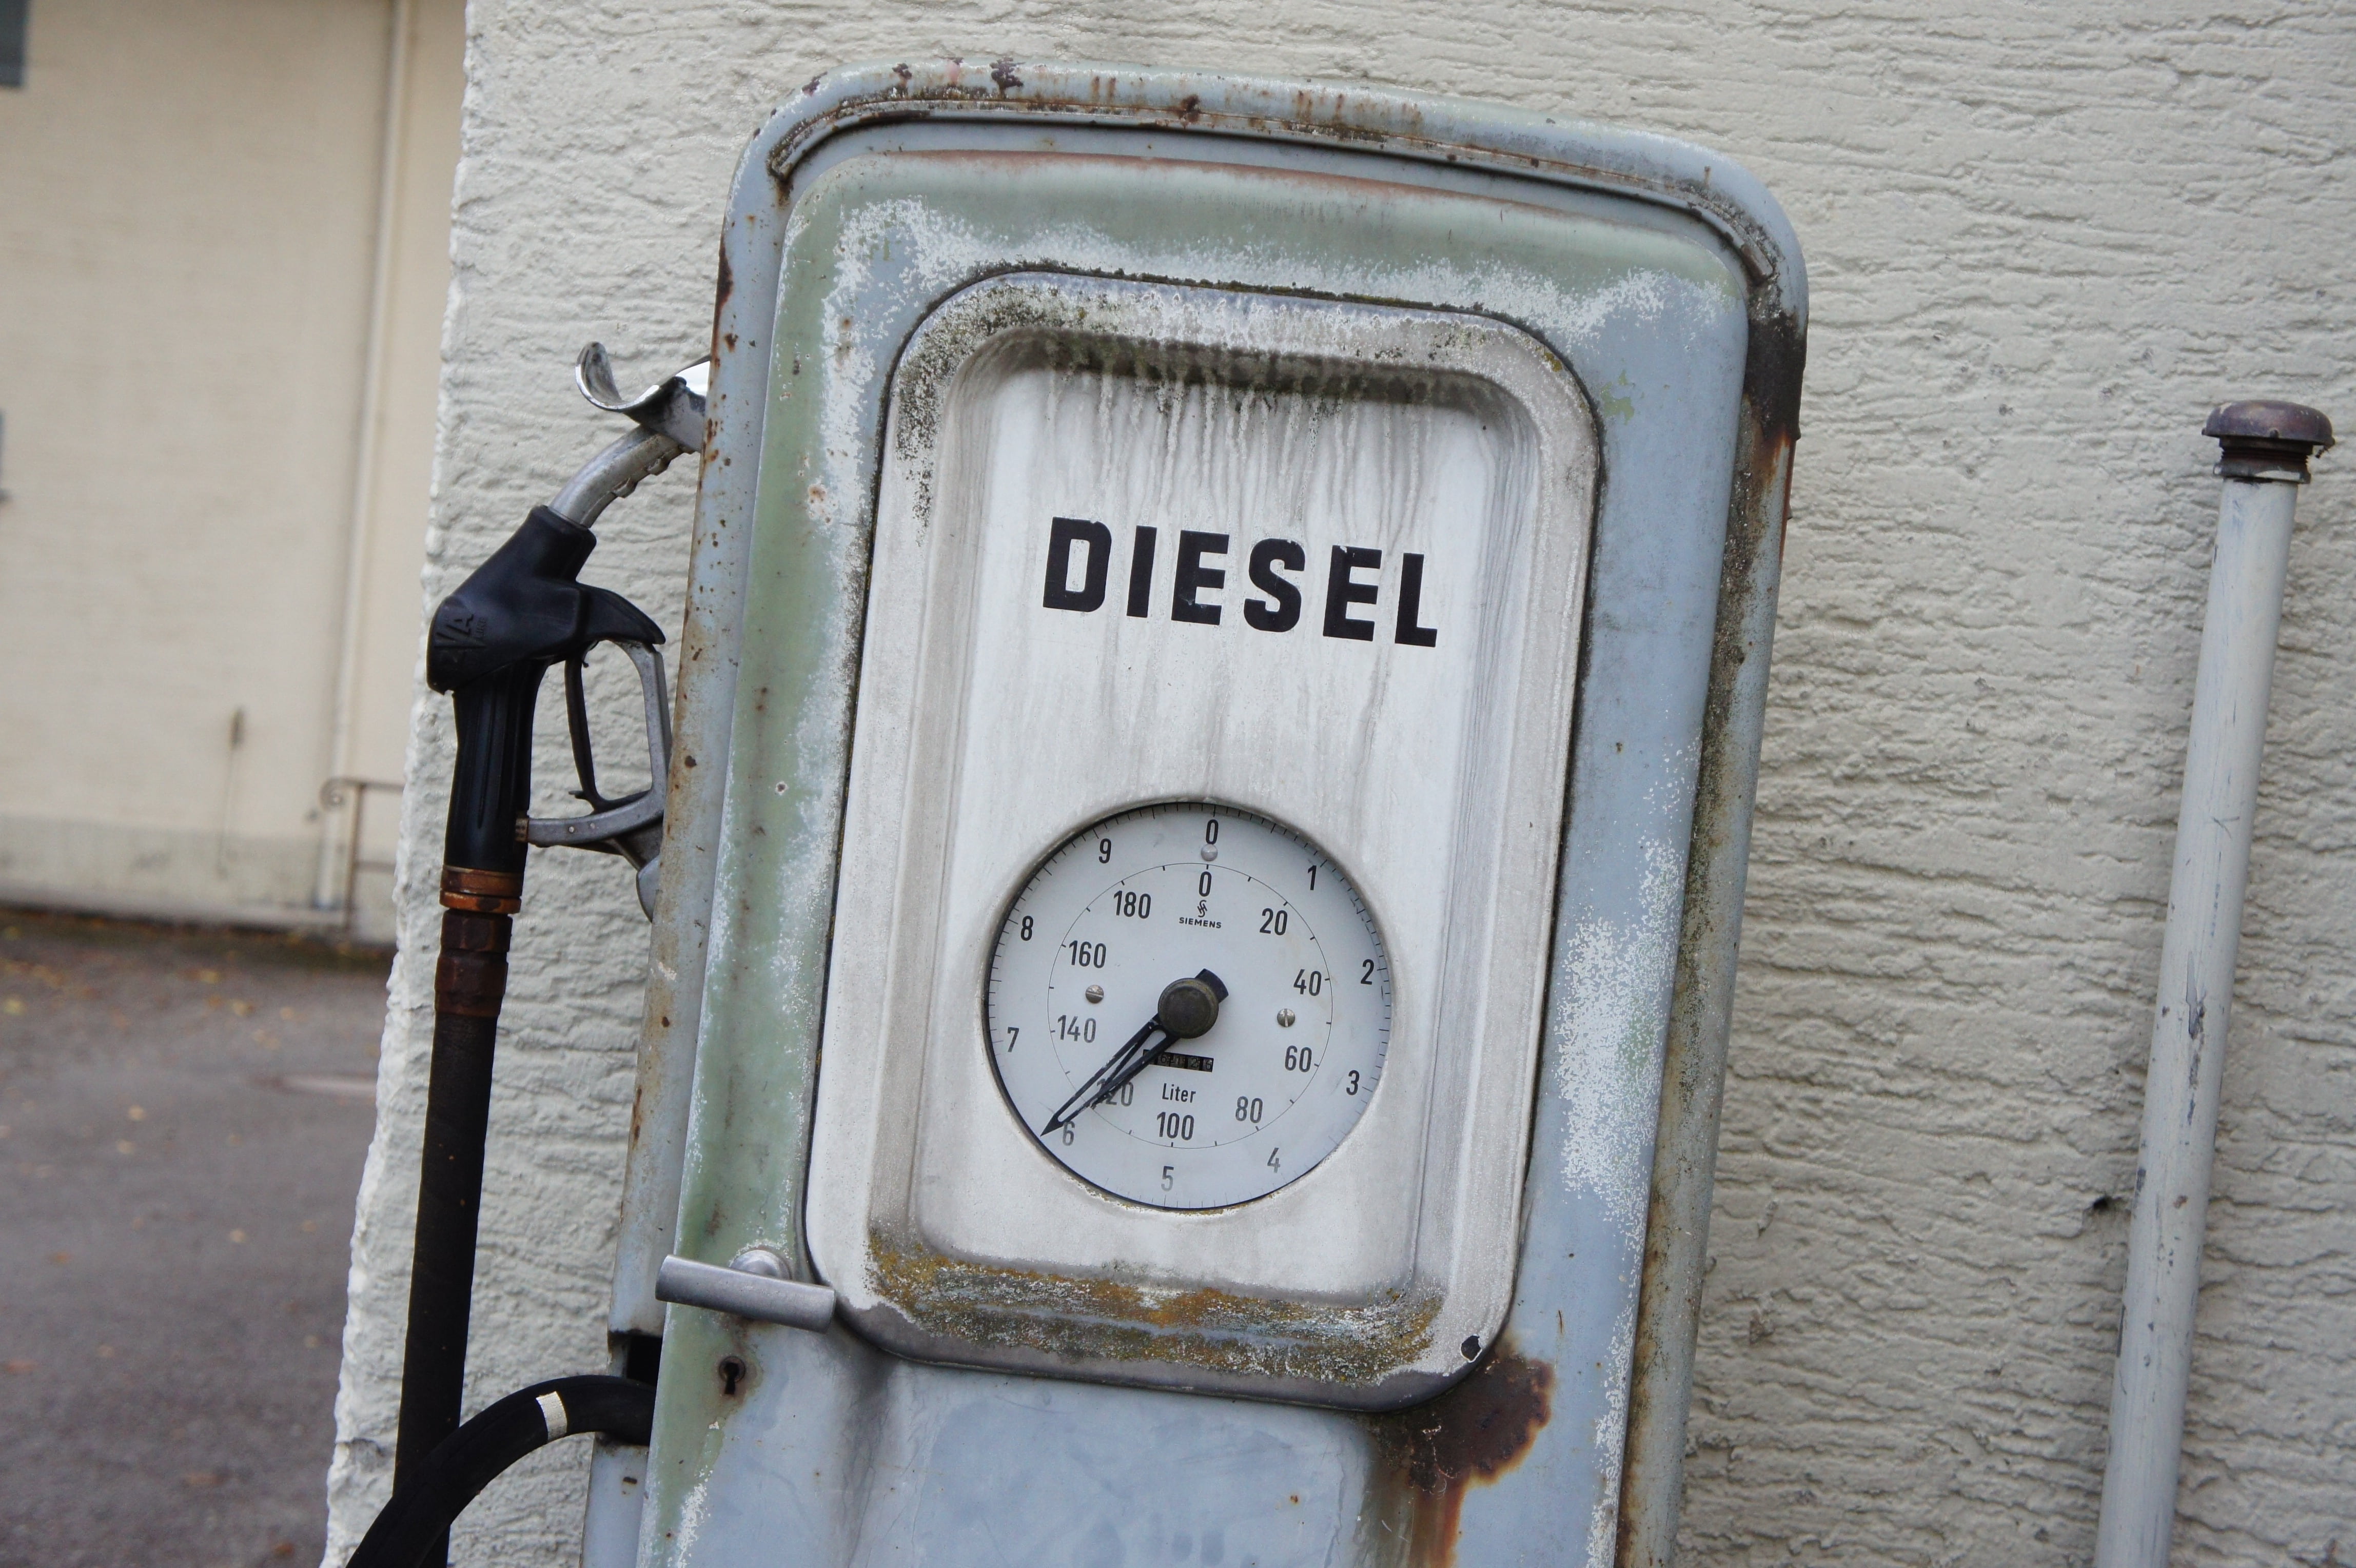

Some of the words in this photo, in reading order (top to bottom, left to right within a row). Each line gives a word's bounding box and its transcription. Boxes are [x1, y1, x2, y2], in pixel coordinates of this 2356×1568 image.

[1043, 516, 1437, 648] DIESEL
[1206, 819, 1219, 845] 0
[1099, 838, 1111, 864] 9
[1199, 871, 1212, 897] 0
[1307, 866, 1317, 890] 1
[1113, 890, 1151, 919] 180
[1020, 915, 1033, 941] 8
[1179, 917, 1222, 929] SIEMENS
[1260, 908, 1288, 935] 20
[1069, 940, 1106, 969] 160
[1293, 969, 1322, 996] 40
[1360, 959, 1374, 985] 2
[1007, 1027, 1019, 1052] 7
[1057, 1015, 1096, 1043] 140
[1285, 1045, 1312, 1072] 60
[1162, 1083, 1196, 1103] Liter
[1346, 1070, 1360, 1095] 3
[1235, 1096, 1263, 1124] 80
[1062, 1121, 1075, 1146] 6
[1156, 1111, 1194, 1141] 100
[1267, 1147, 1281, 1173] 4
[1161, 1166, 1174, 1191] 5
